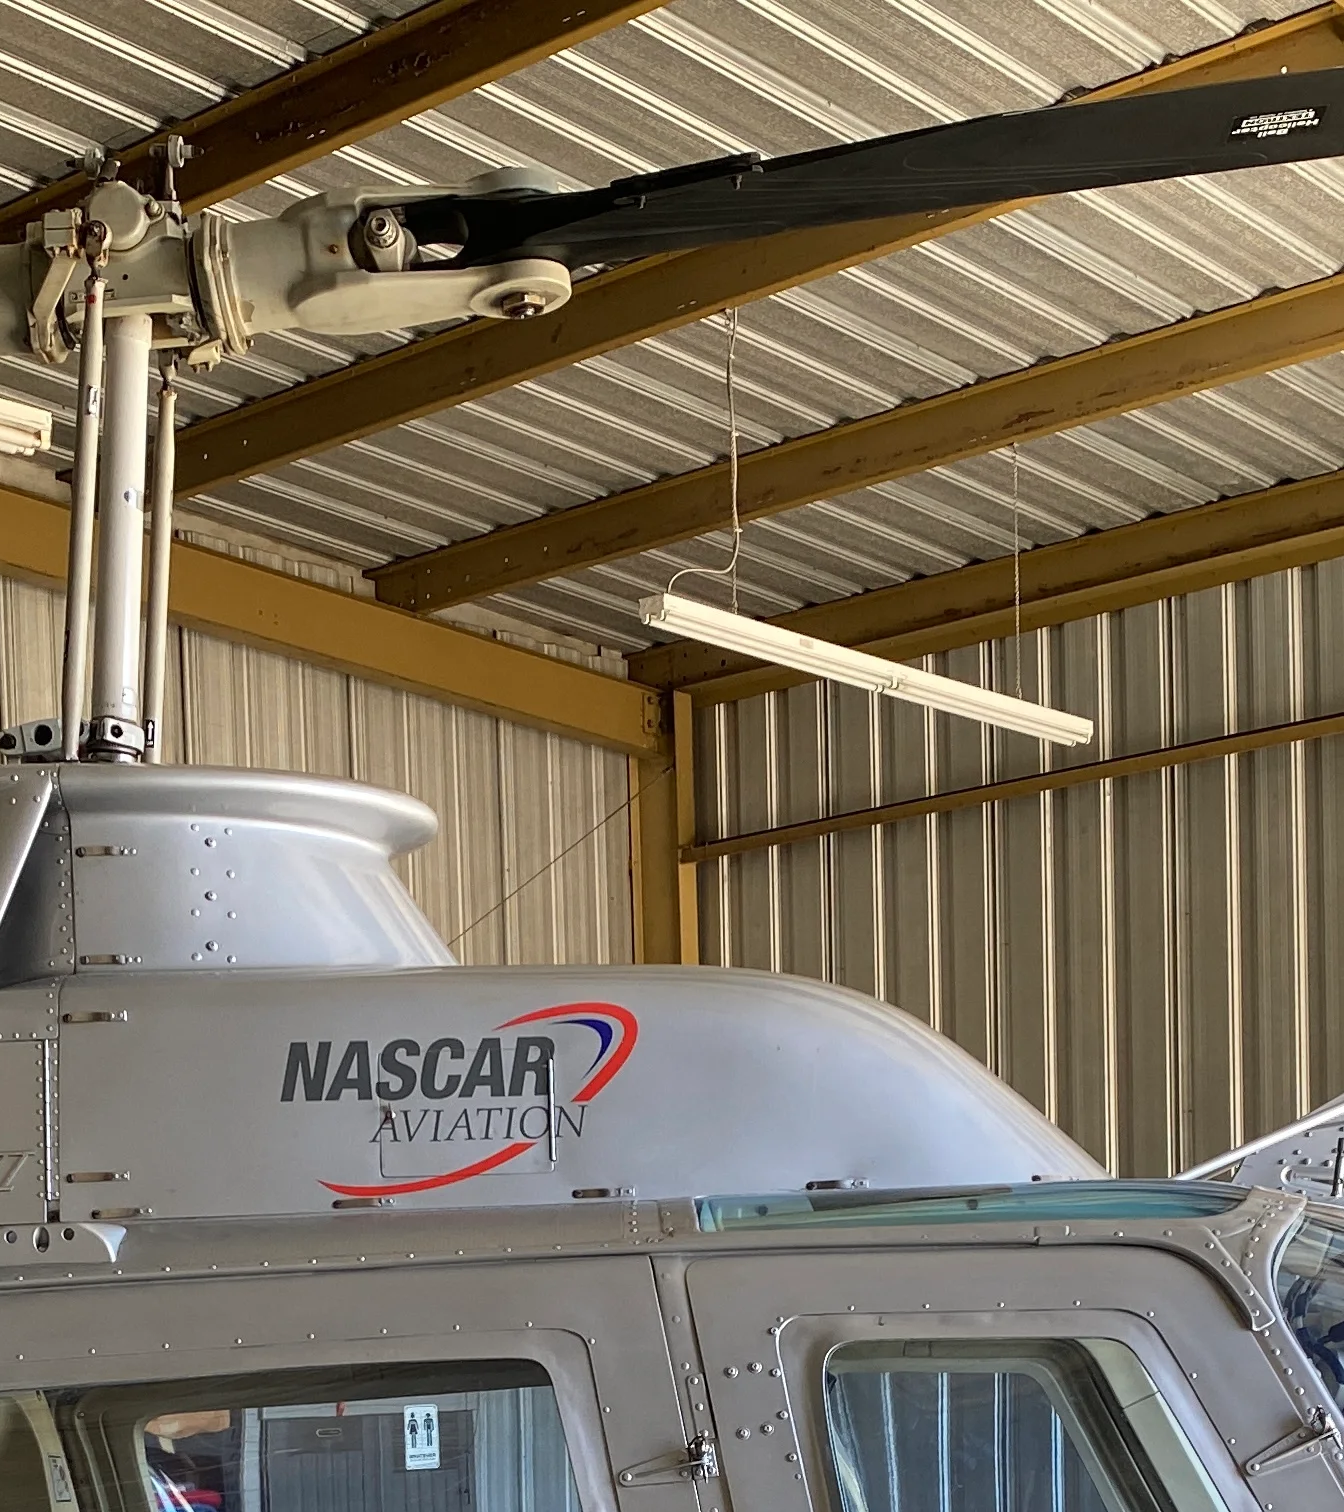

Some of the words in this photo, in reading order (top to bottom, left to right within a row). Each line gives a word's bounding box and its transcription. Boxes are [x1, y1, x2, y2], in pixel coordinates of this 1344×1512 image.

[1231, 118, 1320, 135] Helicopter
[1257, 128, 1290, 138] Bell
[280, 1036, 555, 1102] NASCAR
[369, 1105, 589, 1143] AVIATION
